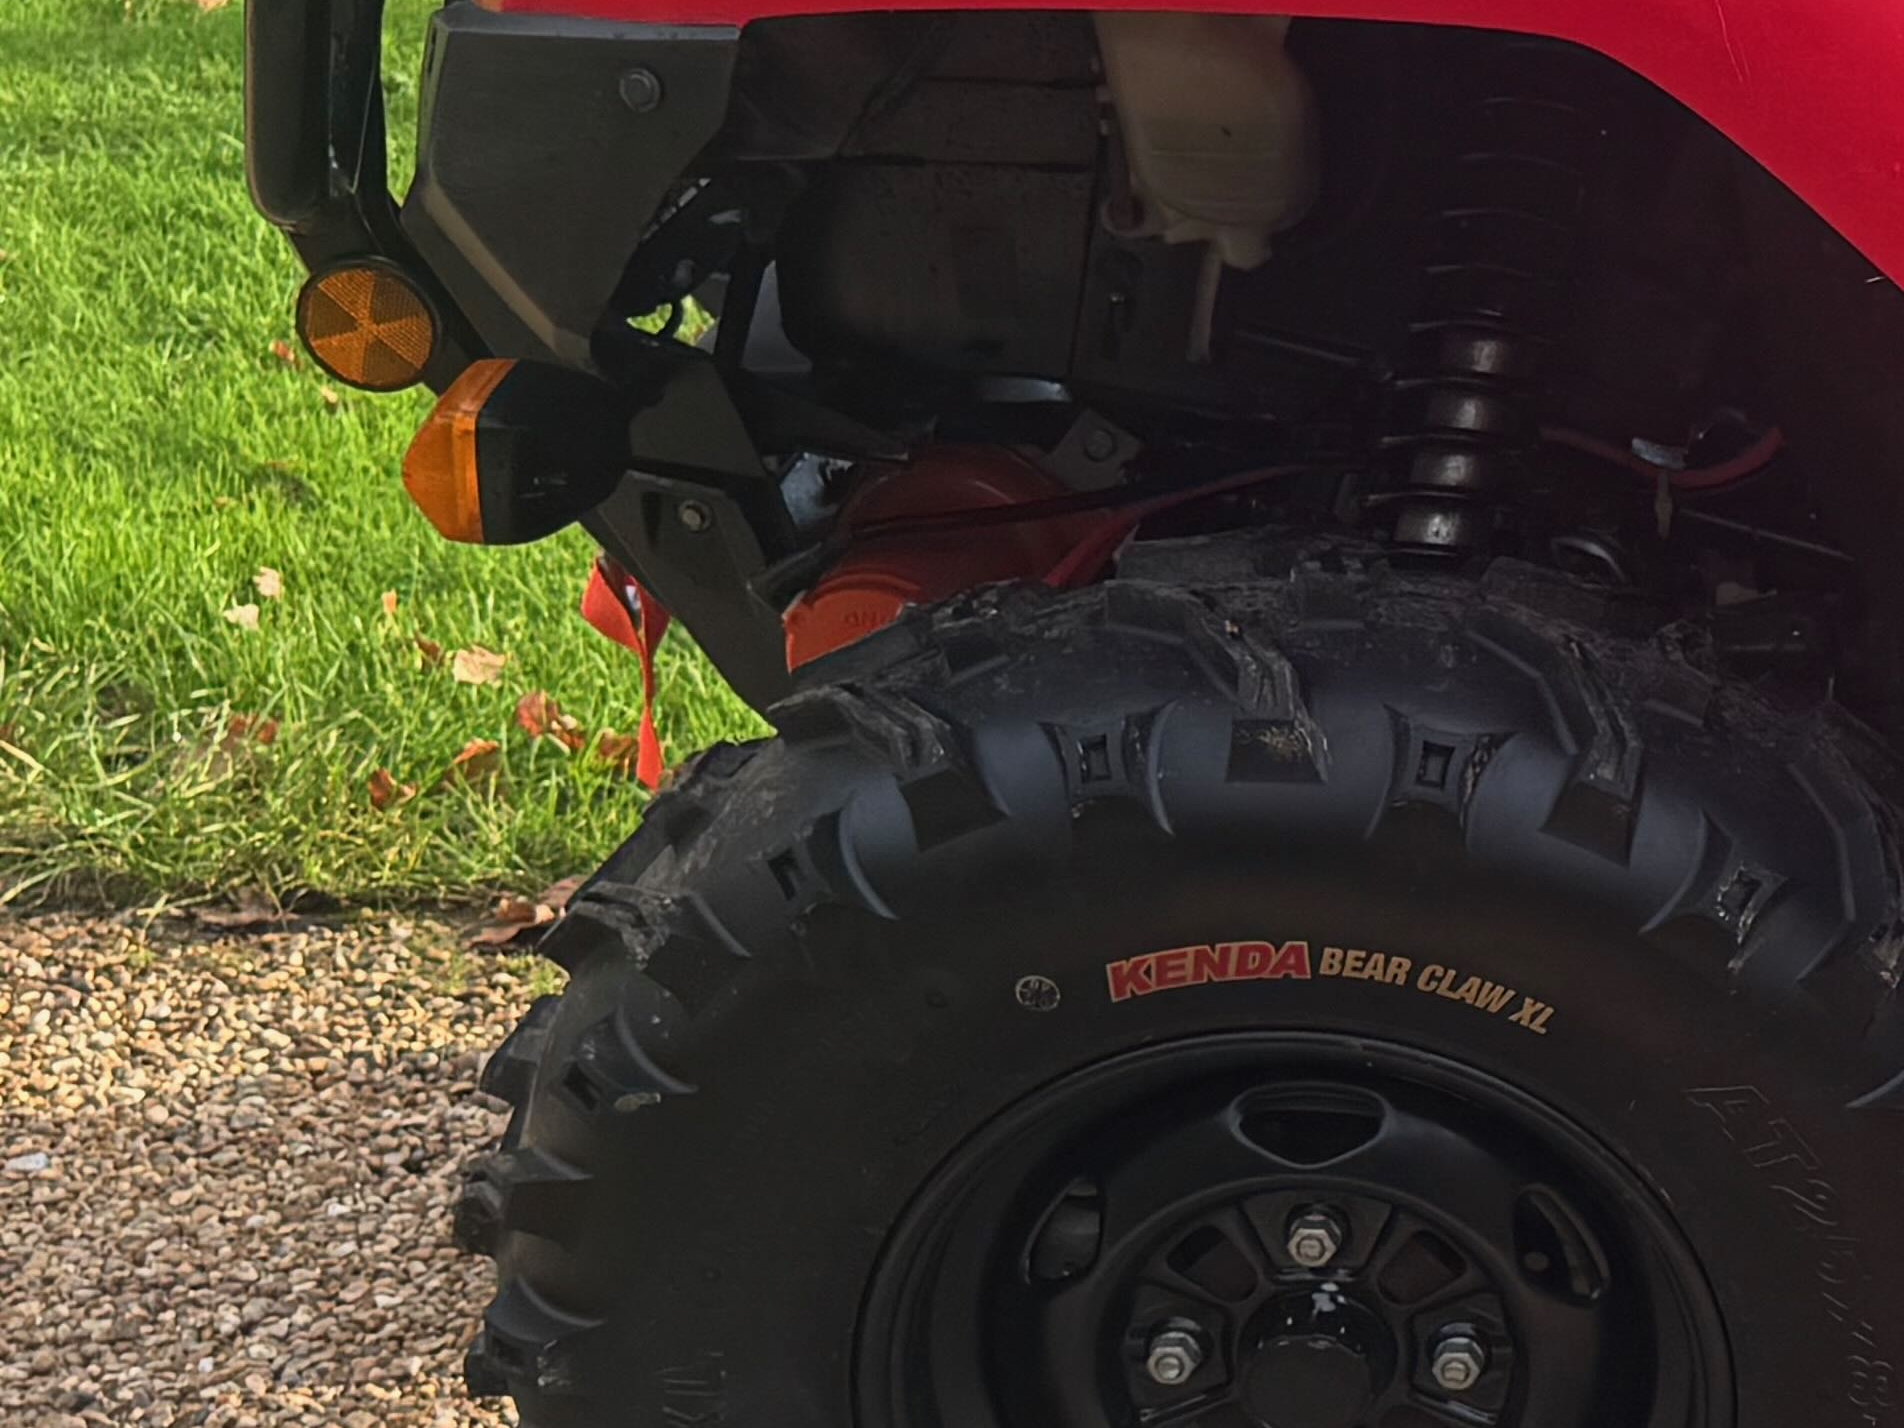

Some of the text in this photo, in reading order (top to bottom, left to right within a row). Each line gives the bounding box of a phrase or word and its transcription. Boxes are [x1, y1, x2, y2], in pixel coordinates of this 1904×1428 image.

[1106, 940, 1312, 1002] KENDA
[1319, 947, 1412, 986] BEAR
[1416, 963, 1515, 1014] CLAW
[1507, 996, 1556, 1035] XL
